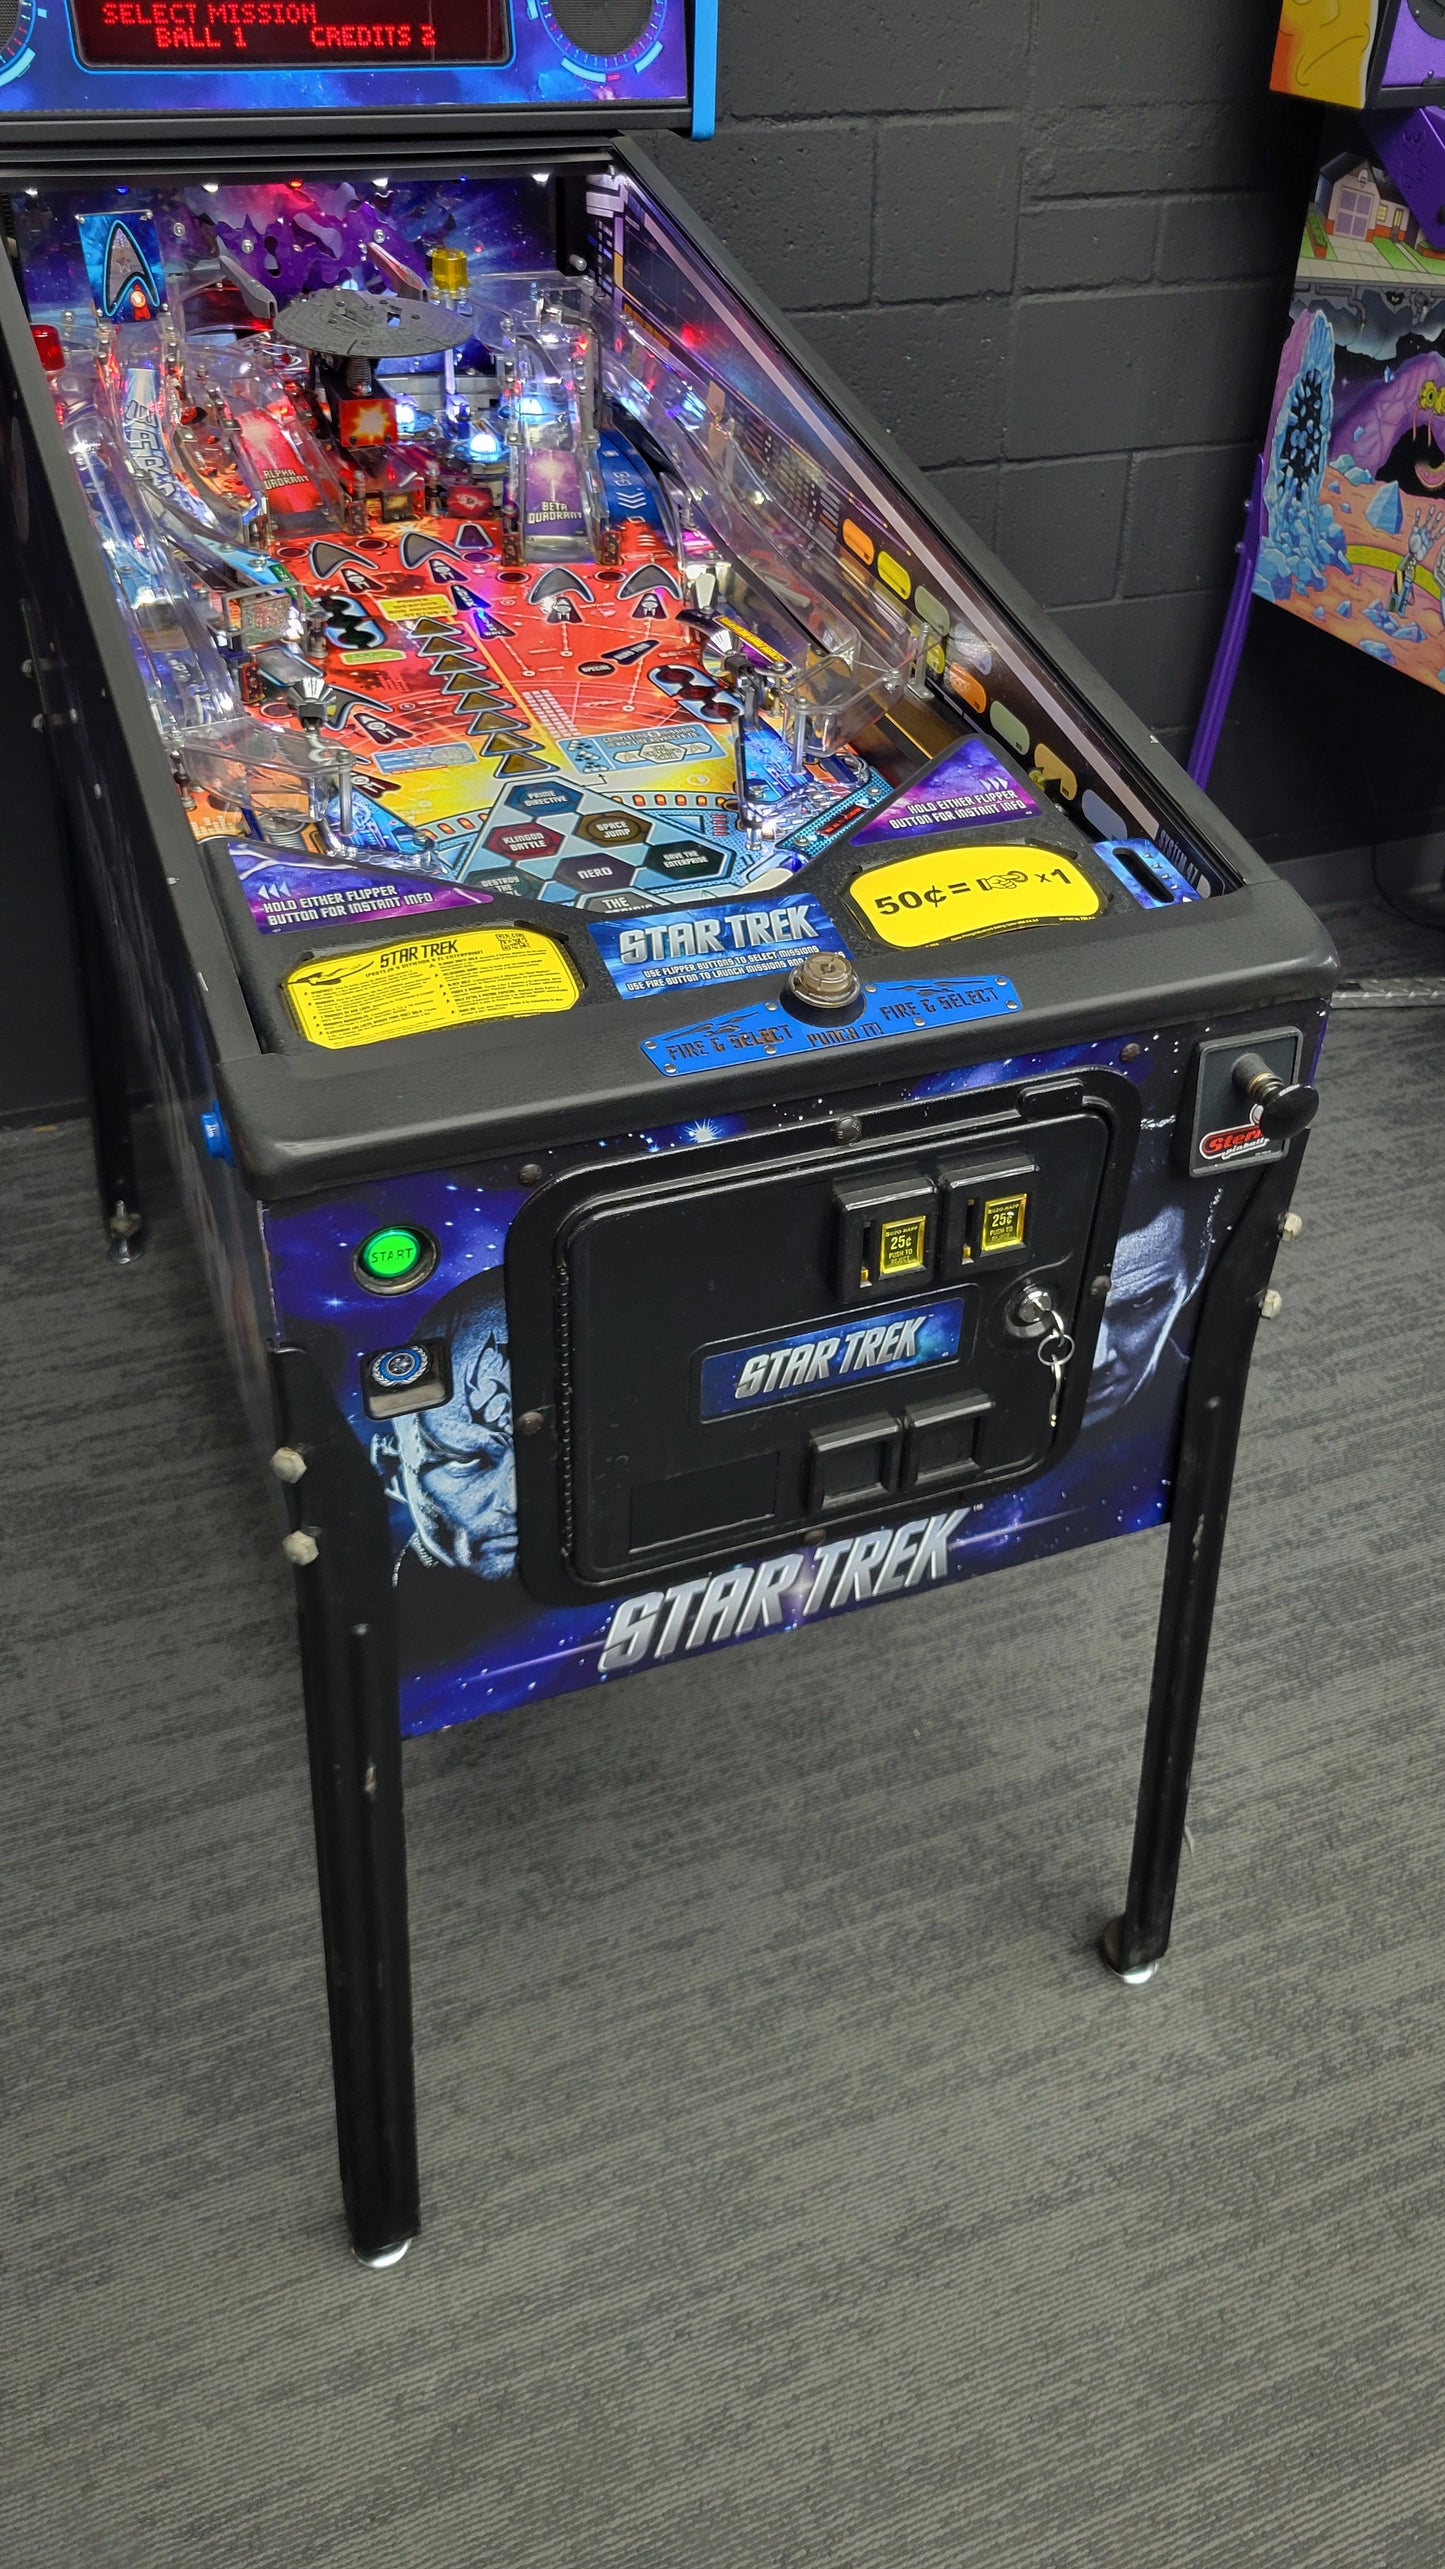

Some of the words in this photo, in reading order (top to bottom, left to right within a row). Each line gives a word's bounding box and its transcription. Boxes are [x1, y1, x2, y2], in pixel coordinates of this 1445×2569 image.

[102, 2, 197, 25] SELECT
[207, 2, 317, 25] MISSION
[155, 26, 221, 49] BALL
[235, 26, 248, 48] 1
[310, 25, 411, 49] CREDITS
[421, 25, 436, 48] 2
[263, 469, 297, 479] ALPHA
[264, 475, 310, 490] UADRANT
[541, 501, 568, 511] BETA
[527, 511, 583, 524] QUADRANT
[523, 795, 568, 807] DIRECTIVE
[527, 790, 556, 800] PRIME
[907, 803, 937, 815] HOLD
[936, 796, 976, 811] EITHER
[974, 789, 1019, 804] FLIPPER
[889, 815, 933, 829] BUTTON
[932, 811, 956, 823] FOR
[955, 804, 1001, 819] INSTANT
[1000, 800, 1027, 812] INFO
[595, 820, 629, 832] SPACE
[603, 828, 631, 839] JUMP
[502, 832, 545, 845] KLINGON
[509, 840, 548, 852] BATTLE
[663, 852, 687, 861] SAVE
[686, 850, 700, 858] THE
[663, 856, 709, 868] ENTERPRISE
[577, 866, 613, 880] NERO
[481, 875, 520, 887] DESTROY
[495, 884, 513, 893] THE
[263, 899, 298, 914] HOLD
[300, 893, 345, 909] EITHER
[345, 885, 398, 901] FLIPPER
[601, 896, 630, 910] THE
[267, 909, 320, 926] BUTTON
[321, 904, 348, 919] FOR
[349, 897, 402, 914] INSTANT
[403, 892, 434, 906] INFO
[619, 918, 725, 966] STAR
[725, 904, 819, 949] TREK
[380, 946, 418, 968] STAR
[421, 939, 459, 958] TREK
[643, 969, 661, 978] USE
[662, 963, 696, 975] FLIPPER
[697, 957, 735, 970] BUTTONS
[735, 955, 747, 964] TO
[747, 951, 777, 964] SELECT
[779, 945, 820, 958] MISSIONS
[626, 982, 645, 991] USE
[646, 978, 665, 989] FIRE
[667, 973, 698, 986] BUTTON
[700, 971, 712, 980] TO
[712, 966, 745, 978] LAUNCH
[746, 960, 787, 974] MISSIONS
[879, 1001, 921, 1021] FIRE
[936, 987, 999, 1011] SELECT
[666, 1040, 708, 1061] FIRE
[728, 1024, 793, 1050] SELECT
[806, 1027, 860, 1047] PUNCH
[989, 1228, 1005, 1237] PUSH
[1005, 1225, 1014, 1233] TO
[890, 1234, 912, 1250] 25¢
[371, 1247, 414, 1264] START
[888, 1250, 904, 1259] PUSH
[904, 1248, 913, 1256] TO
[735, 1336, 841, 1399] STAR
[838, 1316, 928, 1375] TREK
[598, 1553, 805, 1672] STAR
[803, 1506, 972, 1617] TREK
